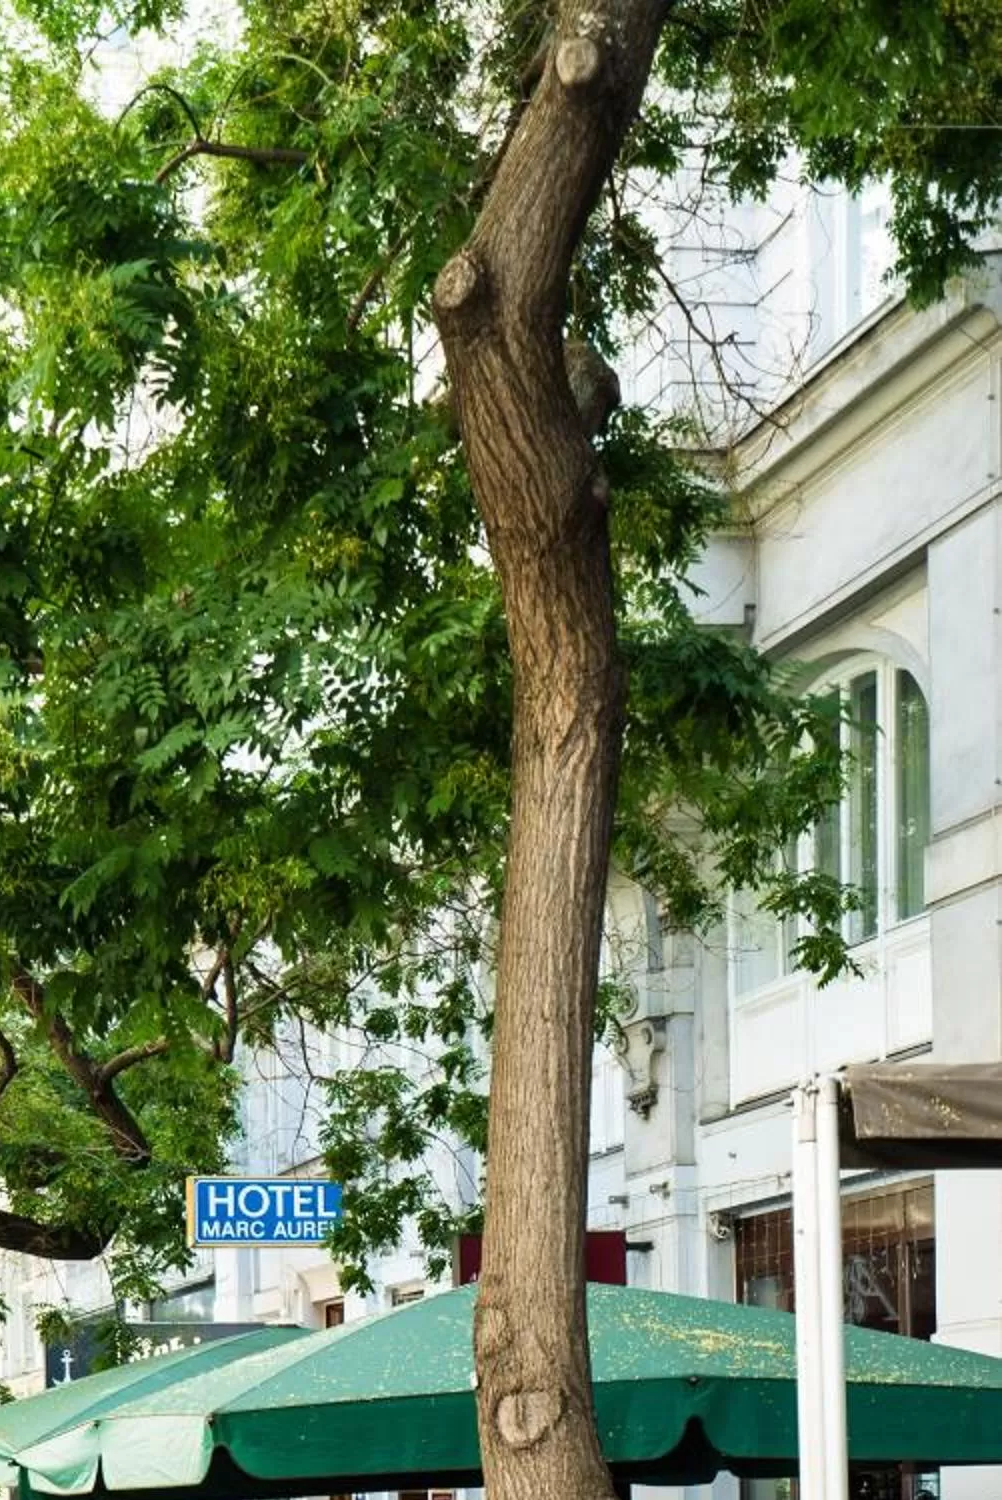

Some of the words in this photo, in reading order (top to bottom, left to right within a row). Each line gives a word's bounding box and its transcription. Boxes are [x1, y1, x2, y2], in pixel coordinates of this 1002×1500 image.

[208, 1184, 336, 1218] HOTEL
[202, 1220, 265, 1238] MARC
[273, 1220, 334, 1238] AURE
